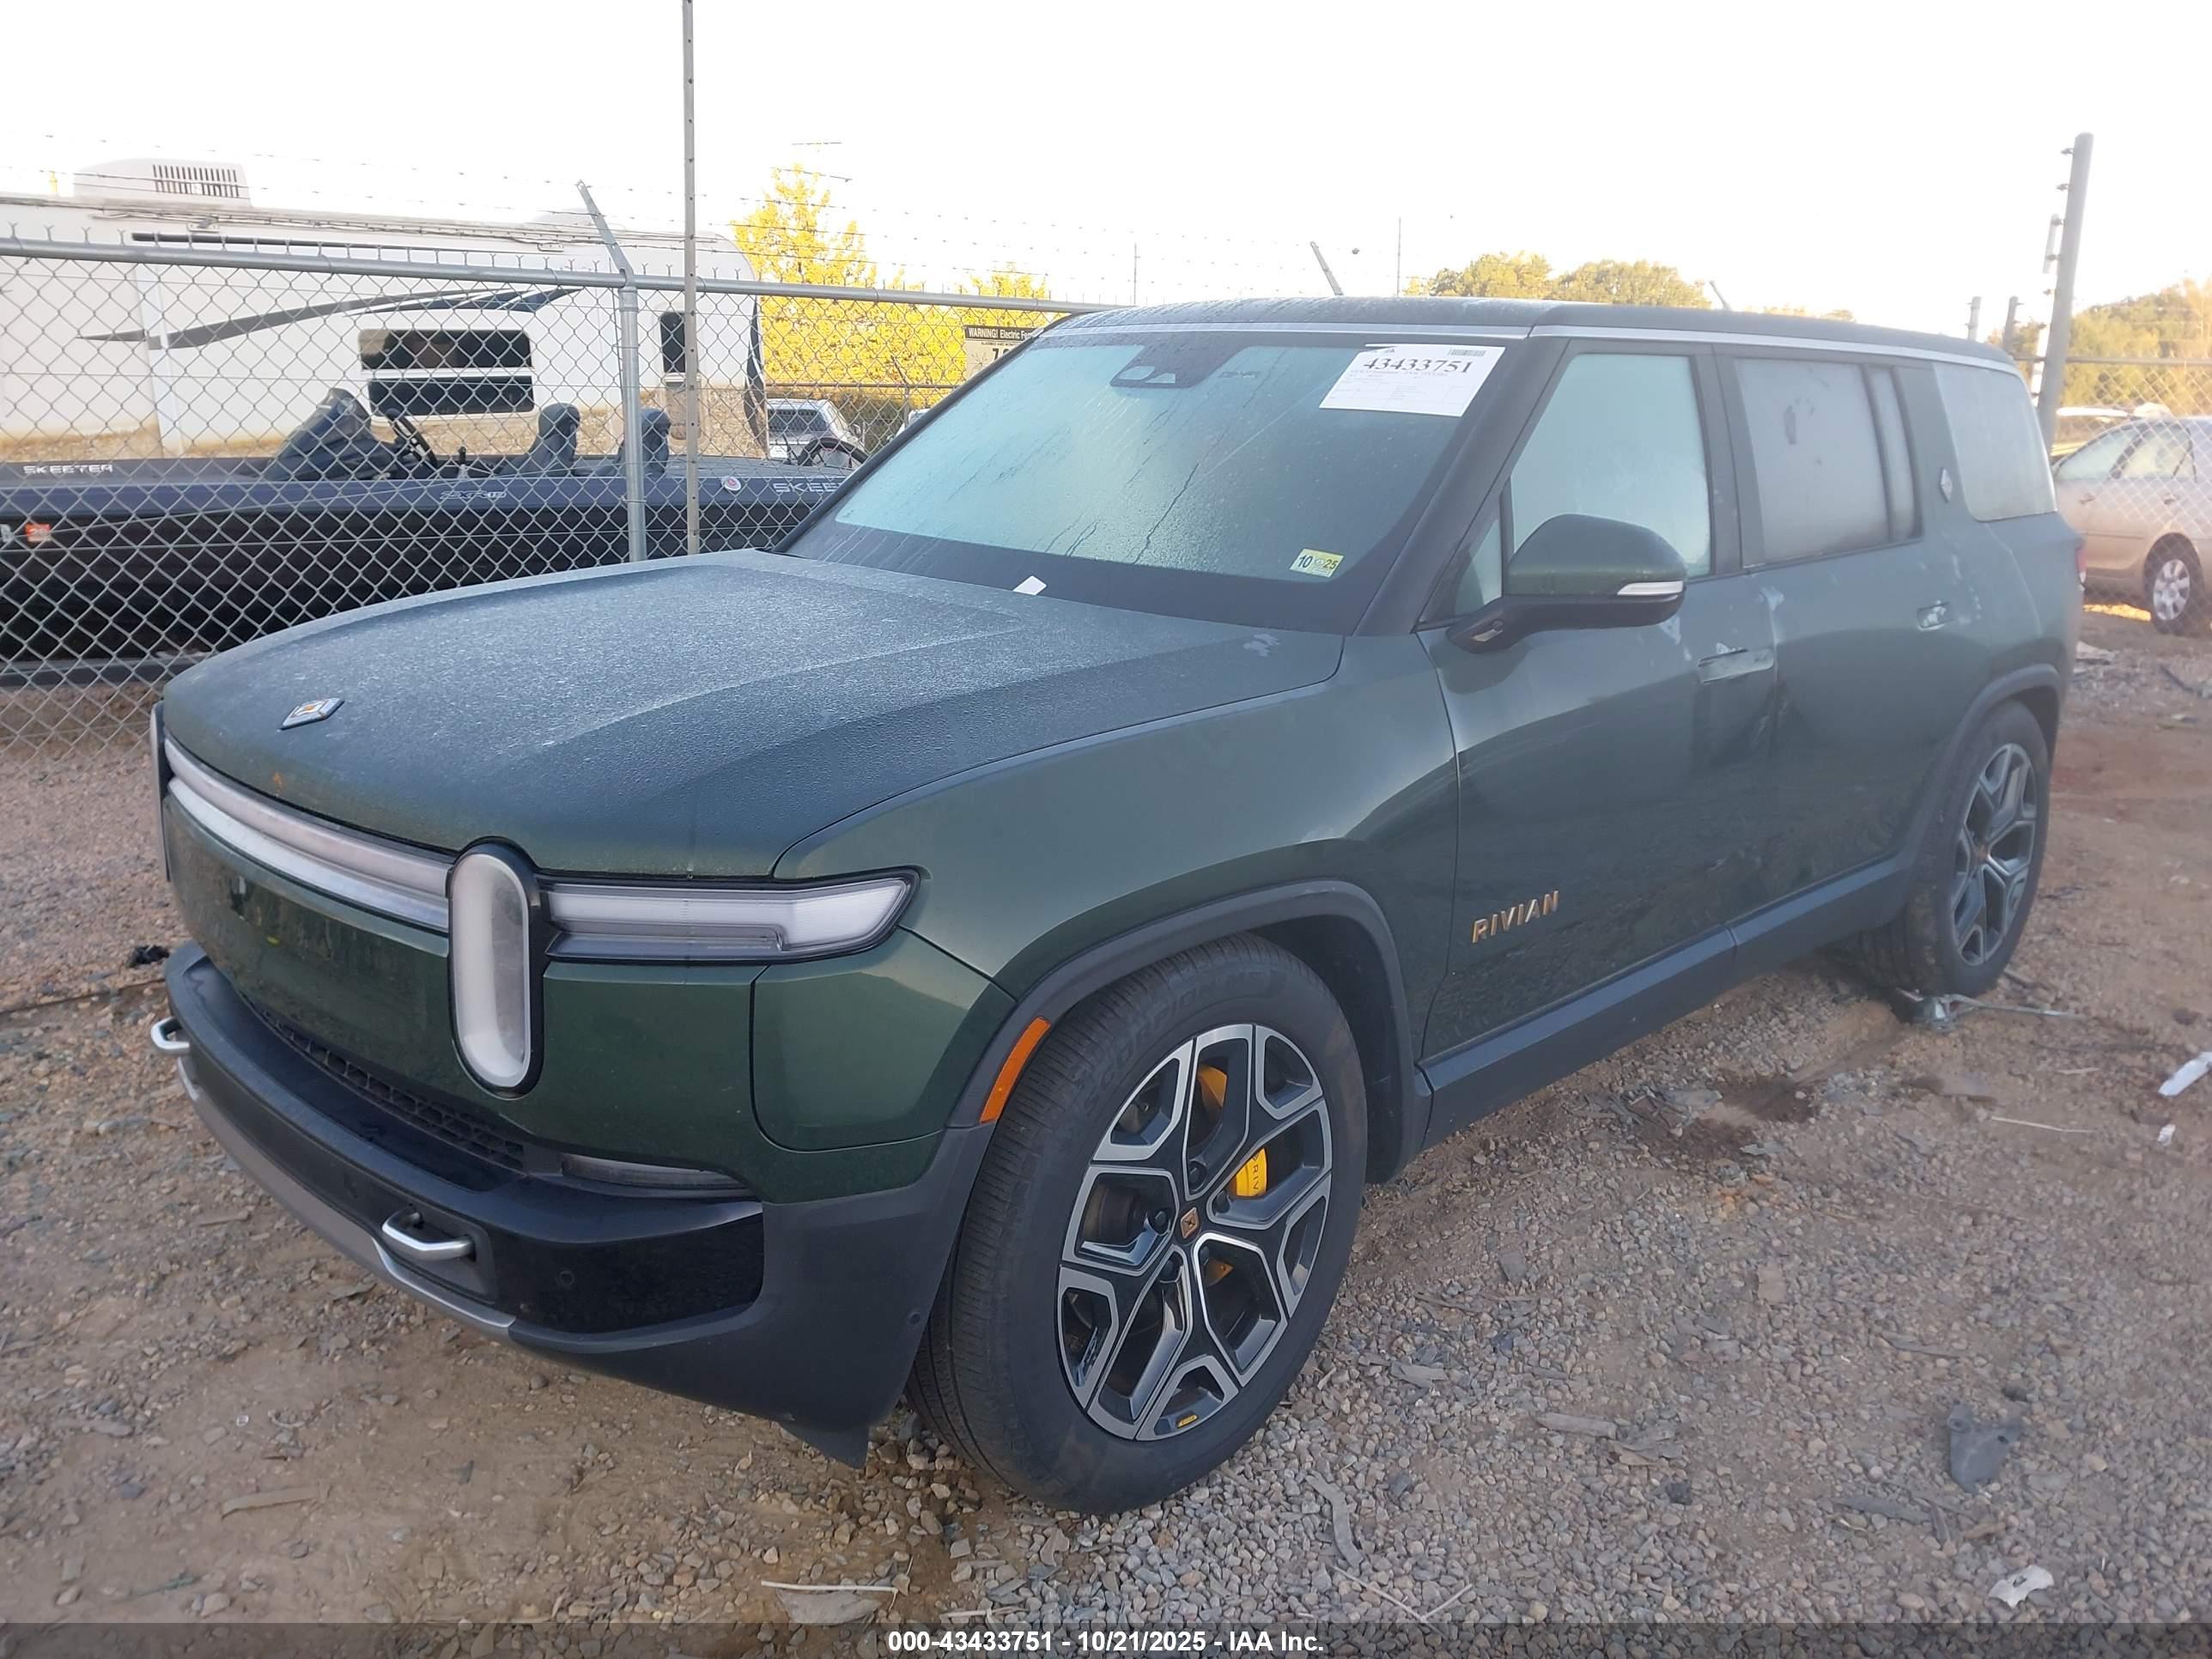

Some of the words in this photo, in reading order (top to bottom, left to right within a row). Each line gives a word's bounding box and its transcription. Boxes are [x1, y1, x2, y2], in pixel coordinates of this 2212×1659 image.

[968, 327, 998, 338] WARNING!
[1000, 330, 1020, 339] Electric
[1364, 357, 1474, 374] 43433751
[23, 465, 112, 474] SKEETER
[1297, 555, 1313, 568] 10
[1322, 558, 1339, 570] 25
[1472, 890, 1559, 944] RIVIAN
